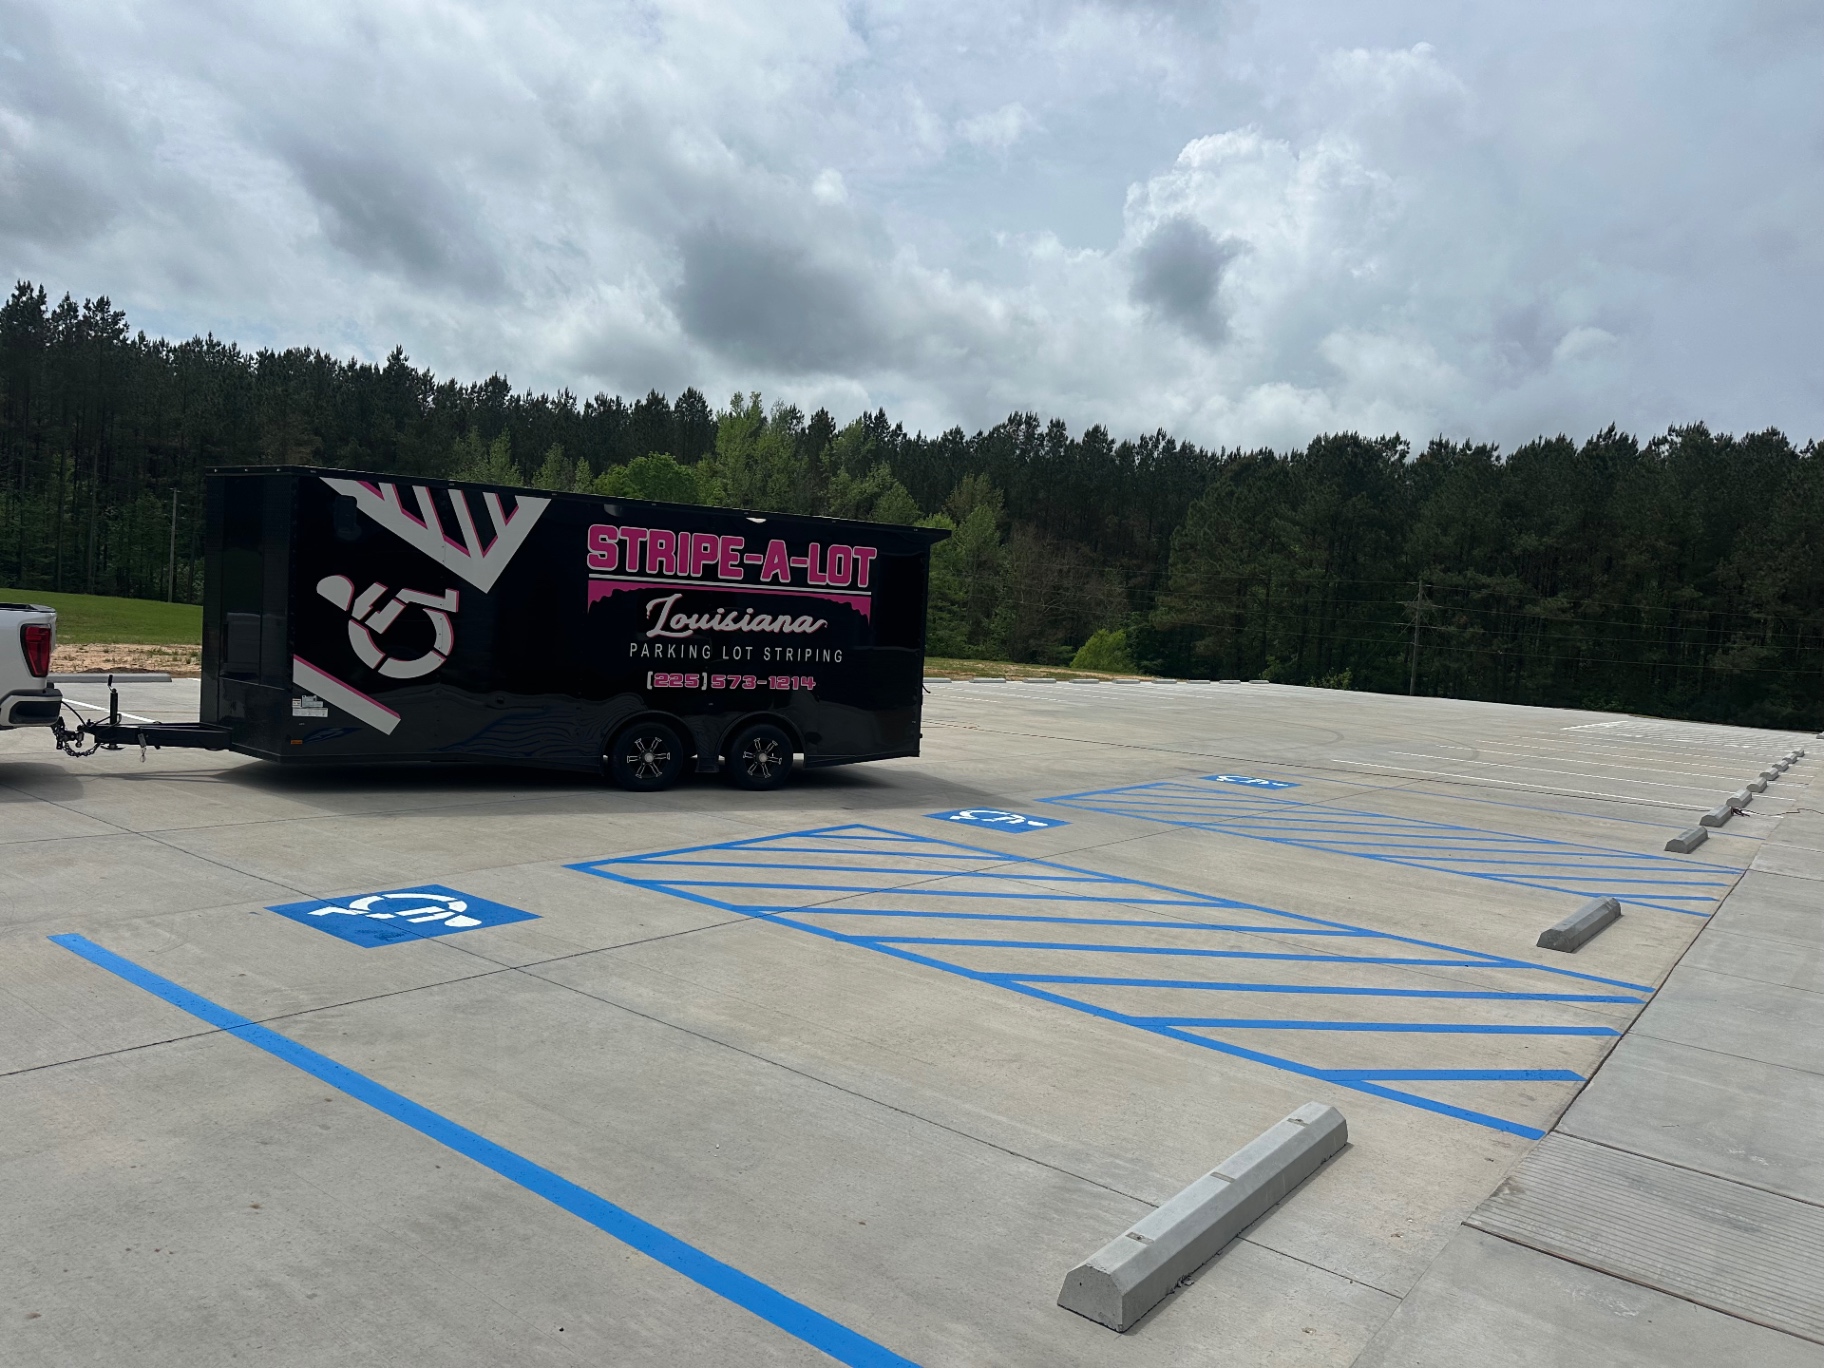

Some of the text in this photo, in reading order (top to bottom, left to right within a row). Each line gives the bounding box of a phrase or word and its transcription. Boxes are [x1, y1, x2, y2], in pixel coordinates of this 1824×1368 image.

[587, 524, 877, 587] STRIPE-A-LOT
[645, 593, 828, 638] Louisiana
[629, 643, 843, 663] PARKING LOT STRIPING
